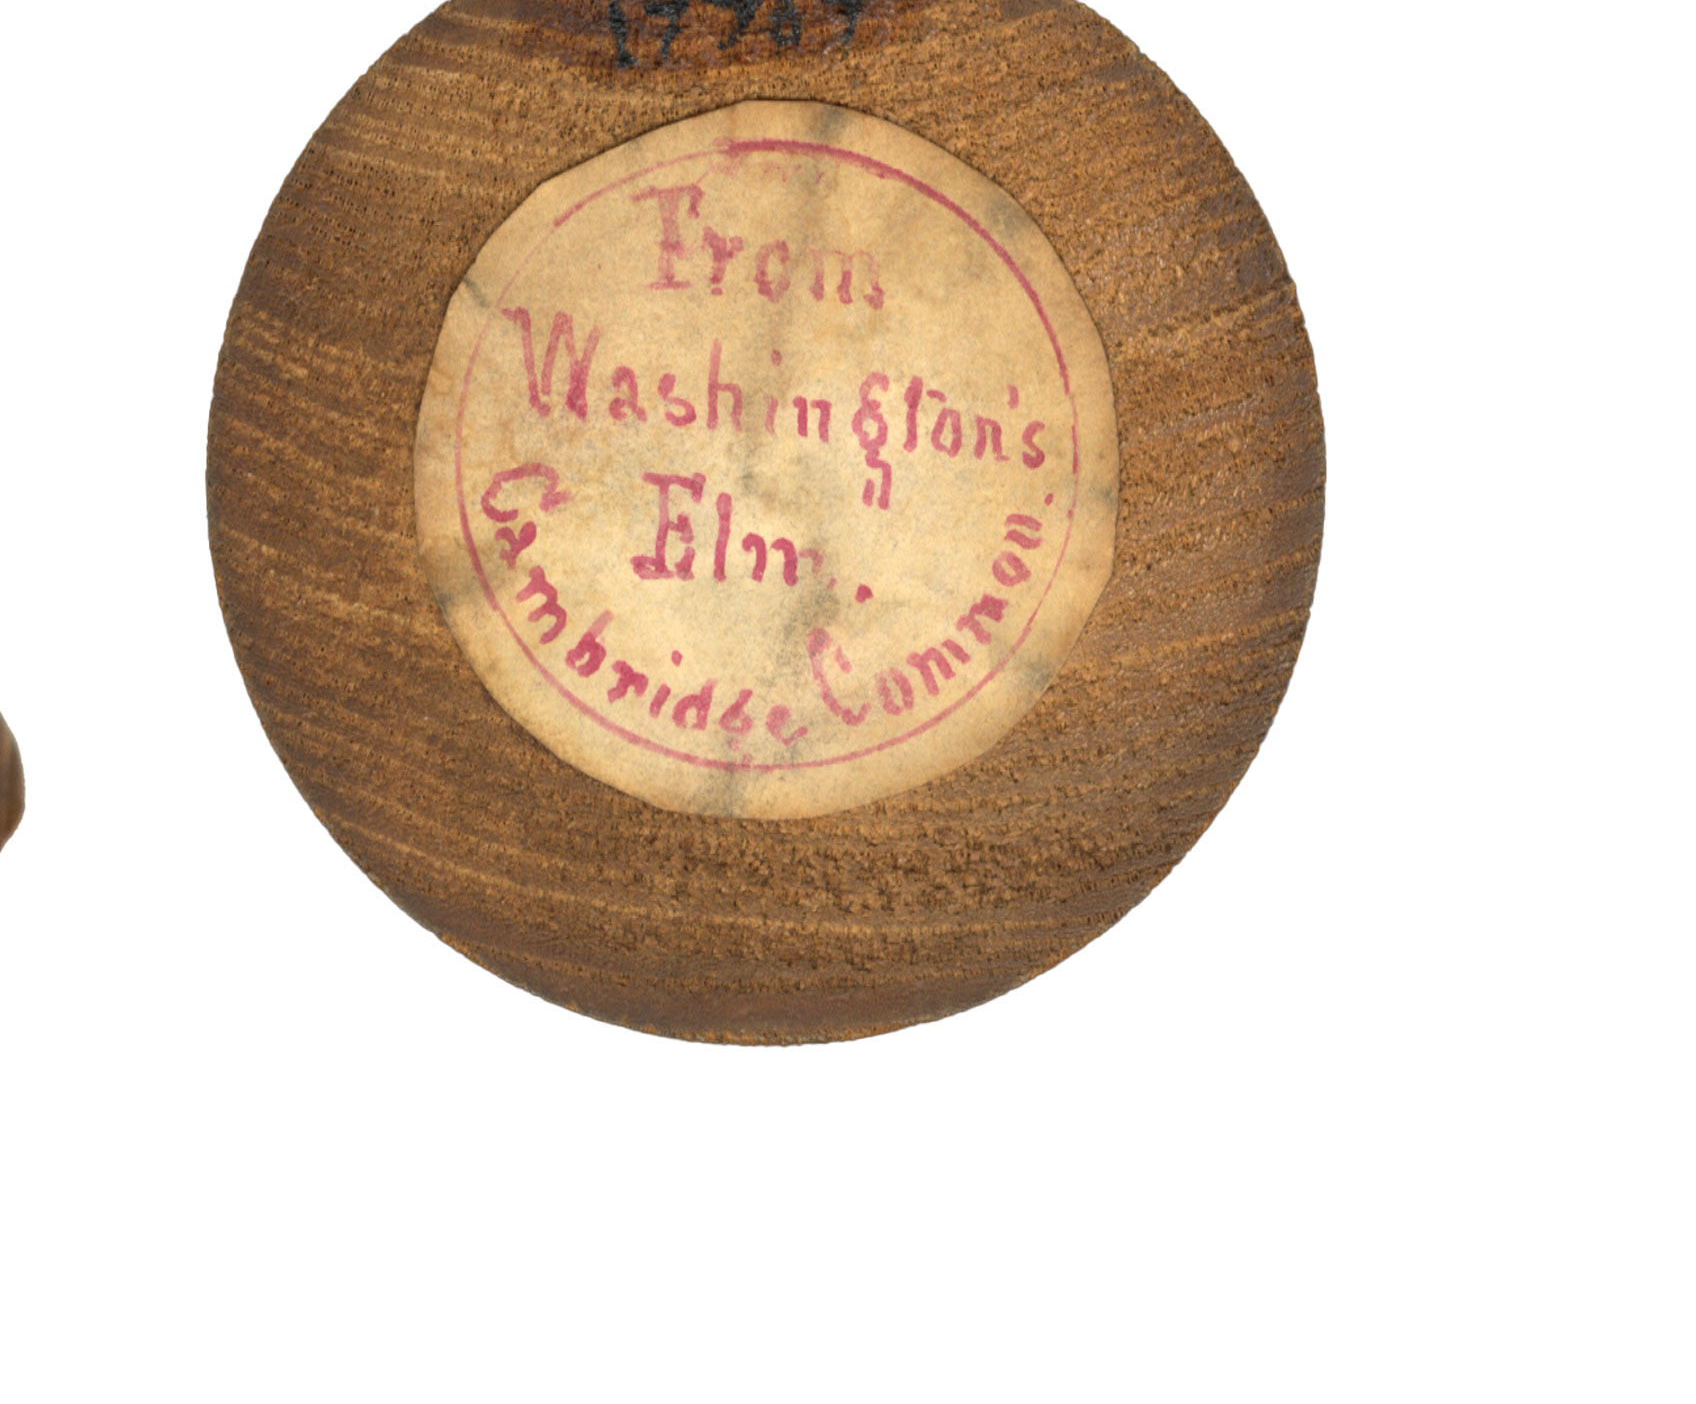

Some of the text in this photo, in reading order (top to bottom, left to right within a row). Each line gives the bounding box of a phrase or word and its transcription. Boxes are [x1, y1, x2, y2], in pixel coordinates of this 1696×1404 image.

[630, 184, 886, 310] From
[502, 306, 1047, 511] Washington's
[479, 461, 808, 761] Cambridge
